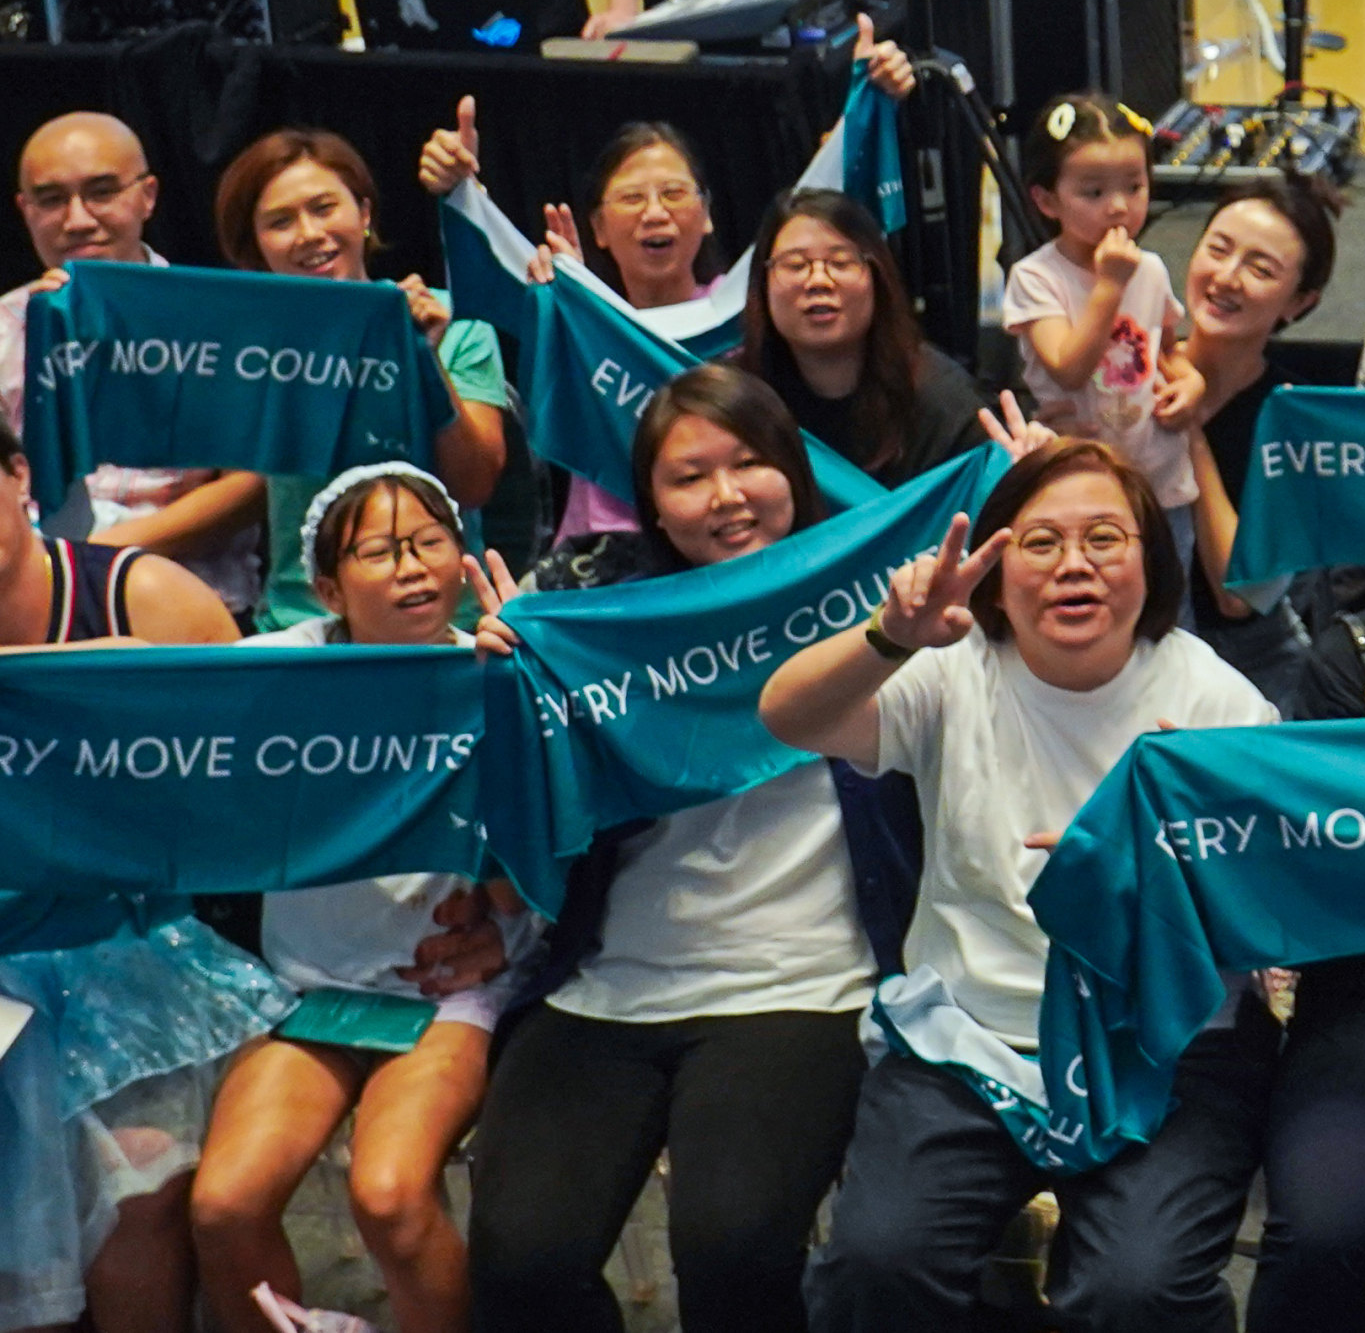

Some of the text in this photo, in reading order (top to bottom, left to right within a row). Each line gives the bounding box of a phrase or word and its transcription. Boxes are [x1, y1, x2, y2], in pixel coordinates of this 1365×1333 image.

[235, 345, 400, 392] COUNTS
[645, 626, 773, 702] MOVE
[74, 736, 235, 779] MOVE
[255, 733, 475, 776] COUNTS
